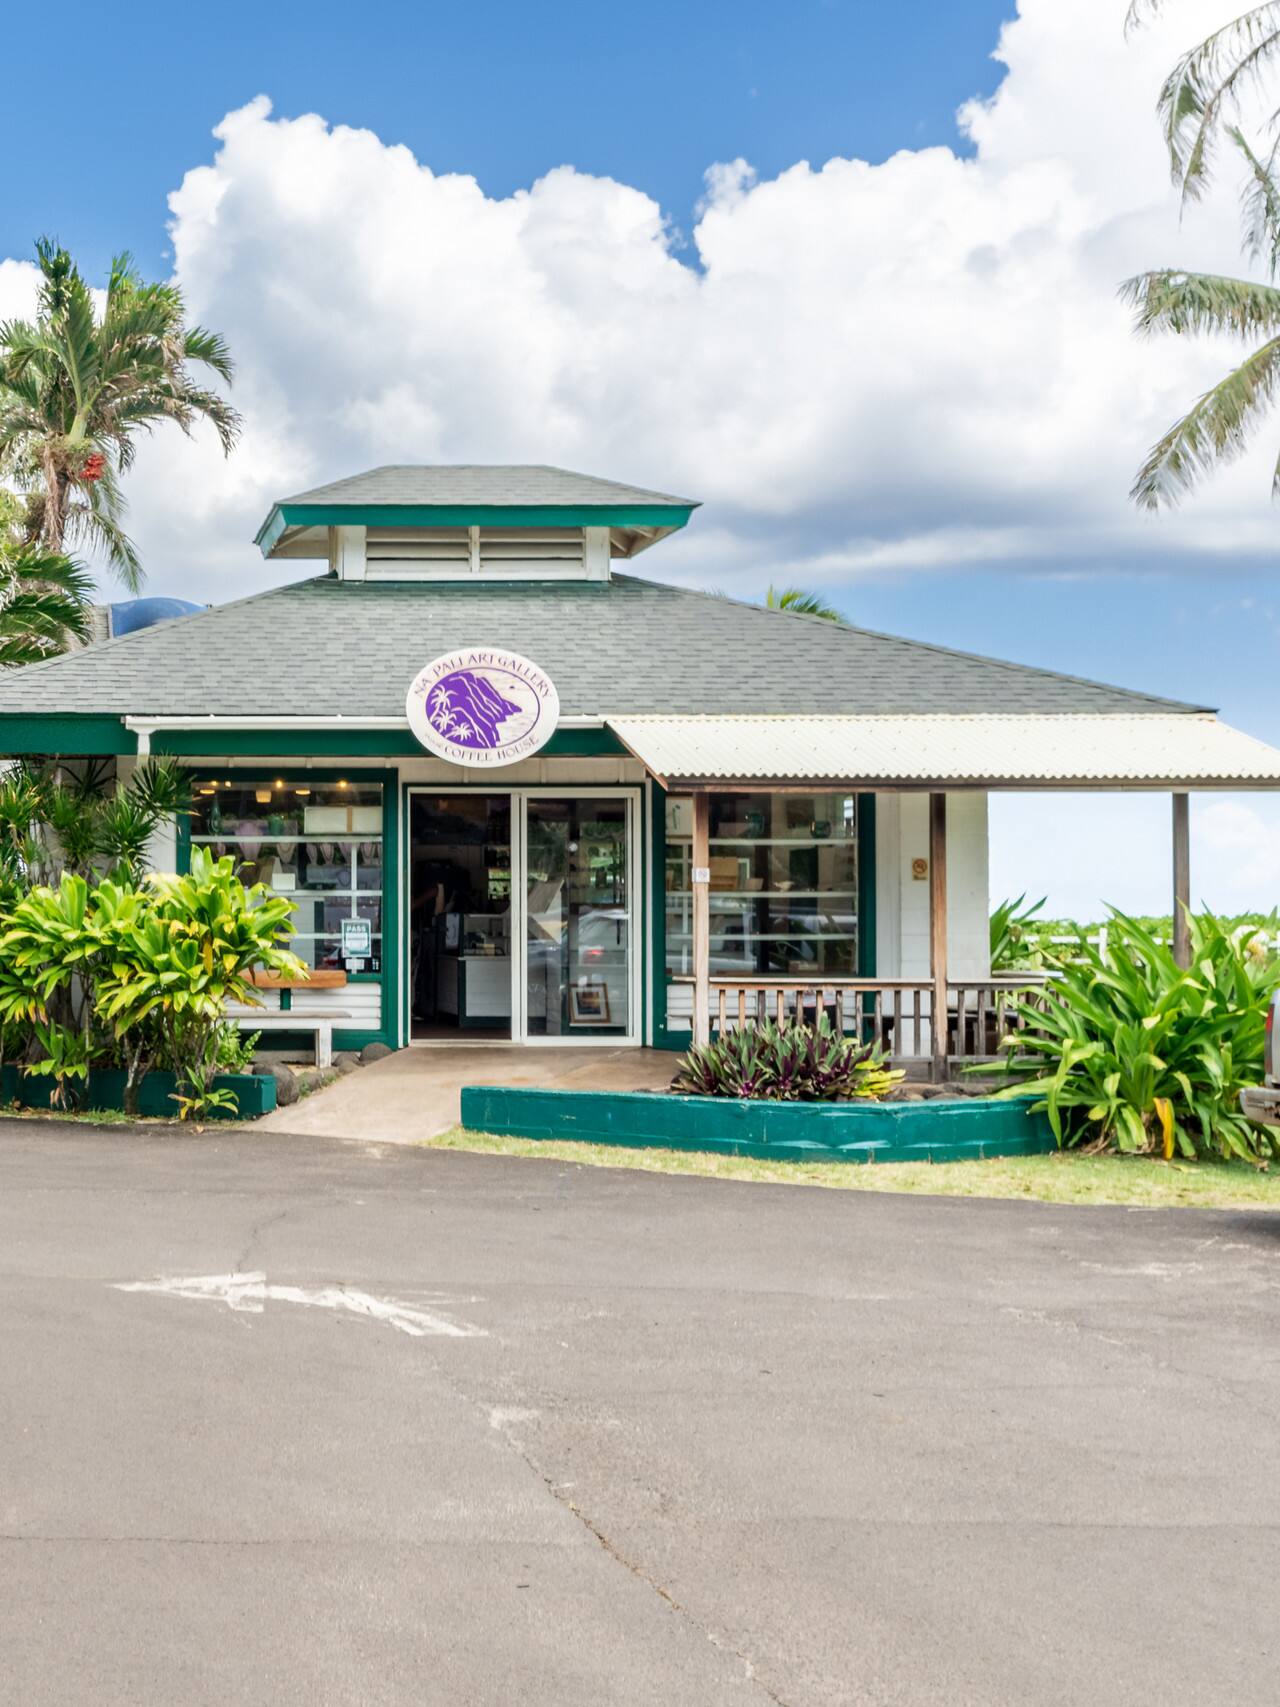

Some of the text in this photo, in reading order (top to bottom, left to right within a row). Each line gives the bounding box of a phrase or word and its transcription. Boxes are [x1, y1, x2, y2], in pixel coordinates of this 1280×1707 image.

[432, 655, 463, 678] PALI
[468, 653, 494, 665] ART
[498, 656, 552, 698] GALLERY
[444, 735, 540, 762] COFFEE HOUSE
